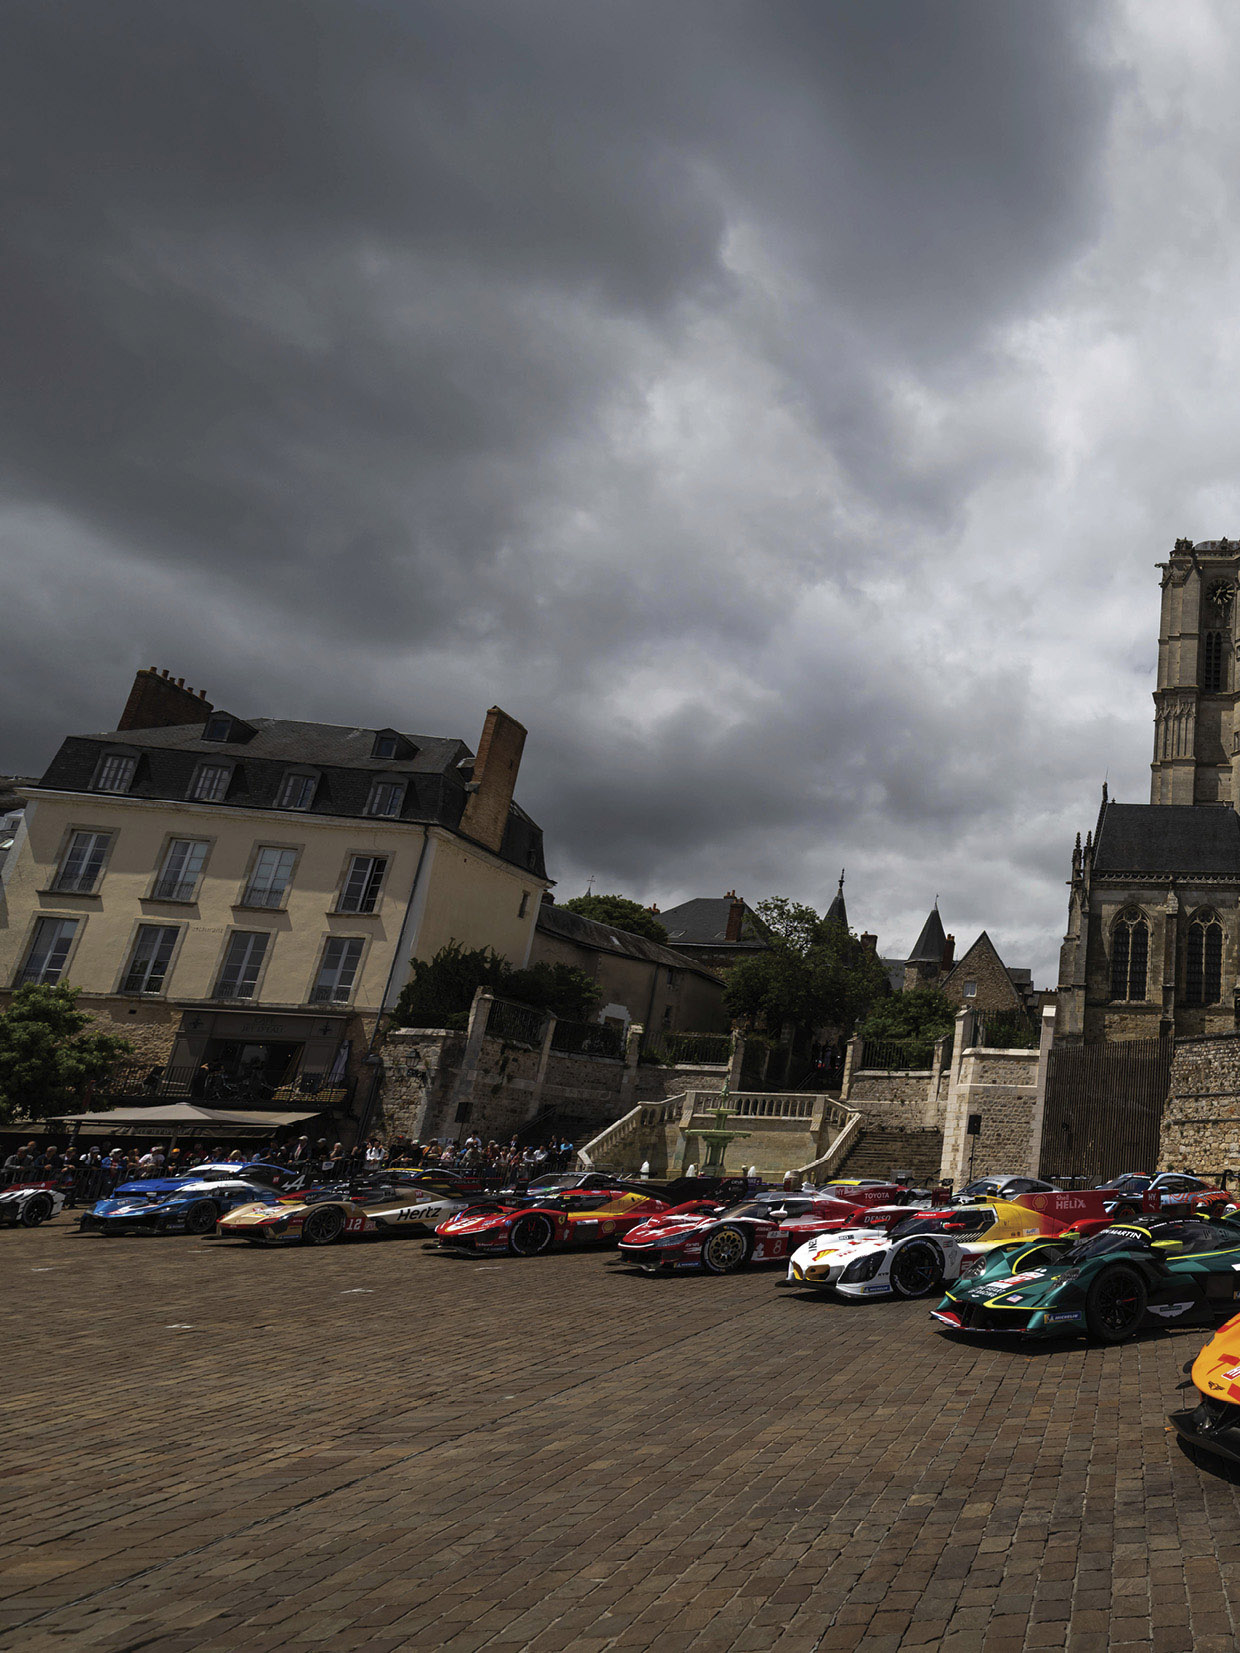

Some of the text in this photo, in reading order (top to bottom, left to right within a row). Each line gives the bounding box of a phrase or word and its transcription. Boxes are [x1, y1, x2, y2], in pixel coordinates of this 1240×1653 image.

[1055, 1199, 1086, 1210] HELIX
[397, 1206, 442, 1221] Hertz
[346, 1218, 362, 1230] 12
[1111, 1229, 1142, 1240] MARTIN
[773, 1240, 782, 1254] 8
